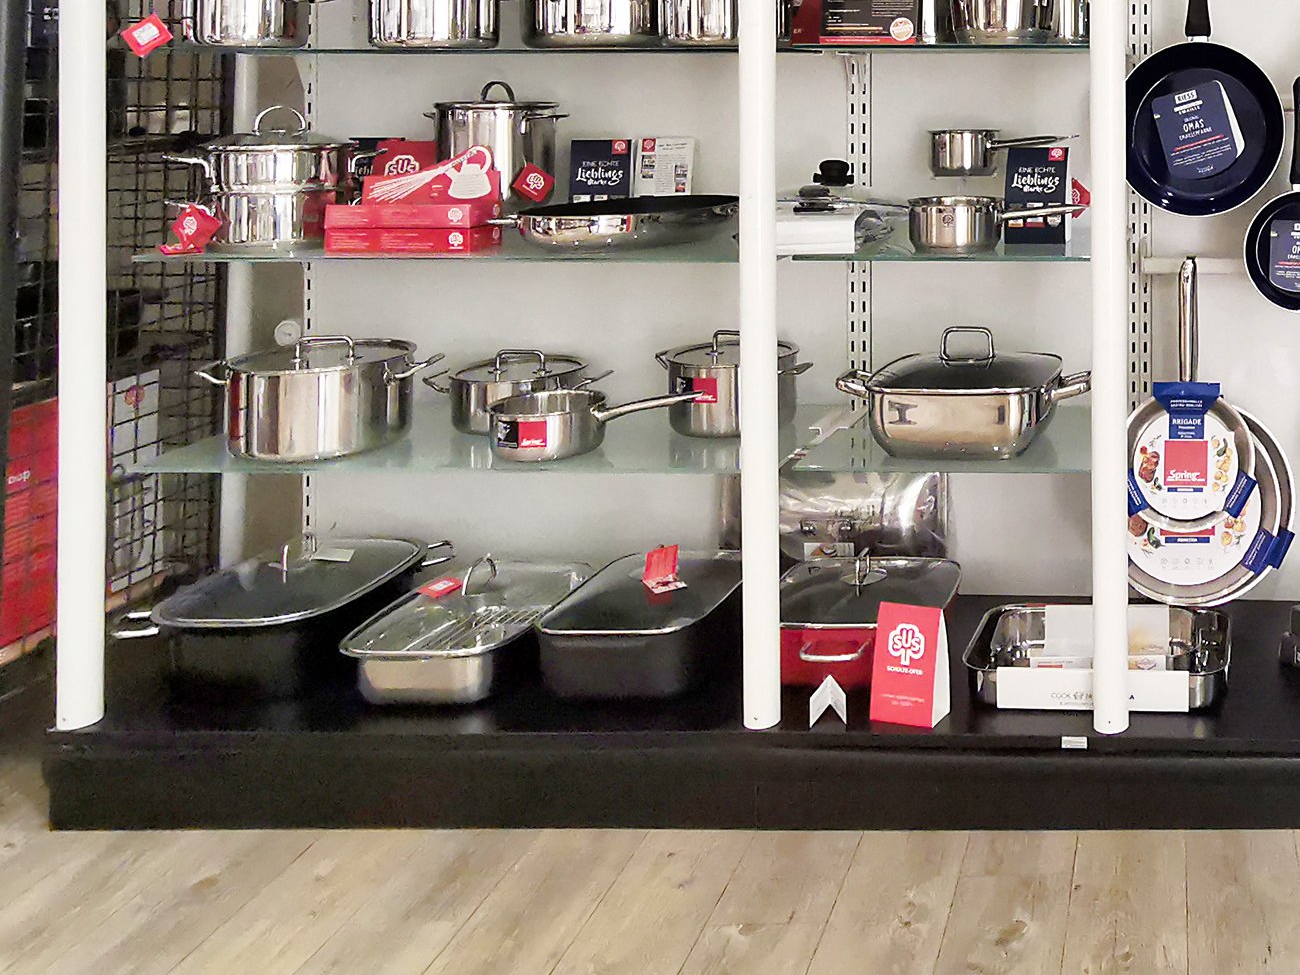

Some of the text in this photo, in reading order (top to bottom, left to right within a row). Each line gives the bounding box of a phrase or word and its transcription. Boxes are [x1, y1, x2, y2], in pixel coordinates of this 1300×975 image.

[1177, 91, 1195, 102] RIESS
[1183, 119, 1205, 133] OMAS
[575, 167, 624, 186] Lieblings
[1018, 166, 1057, 174] EINE ECHTE
[1011, 172, 1060, 194] Lieblings
[1172, 418, 1202, 426] BRIGADE
[1169, 469, 1201, 482] Spring
